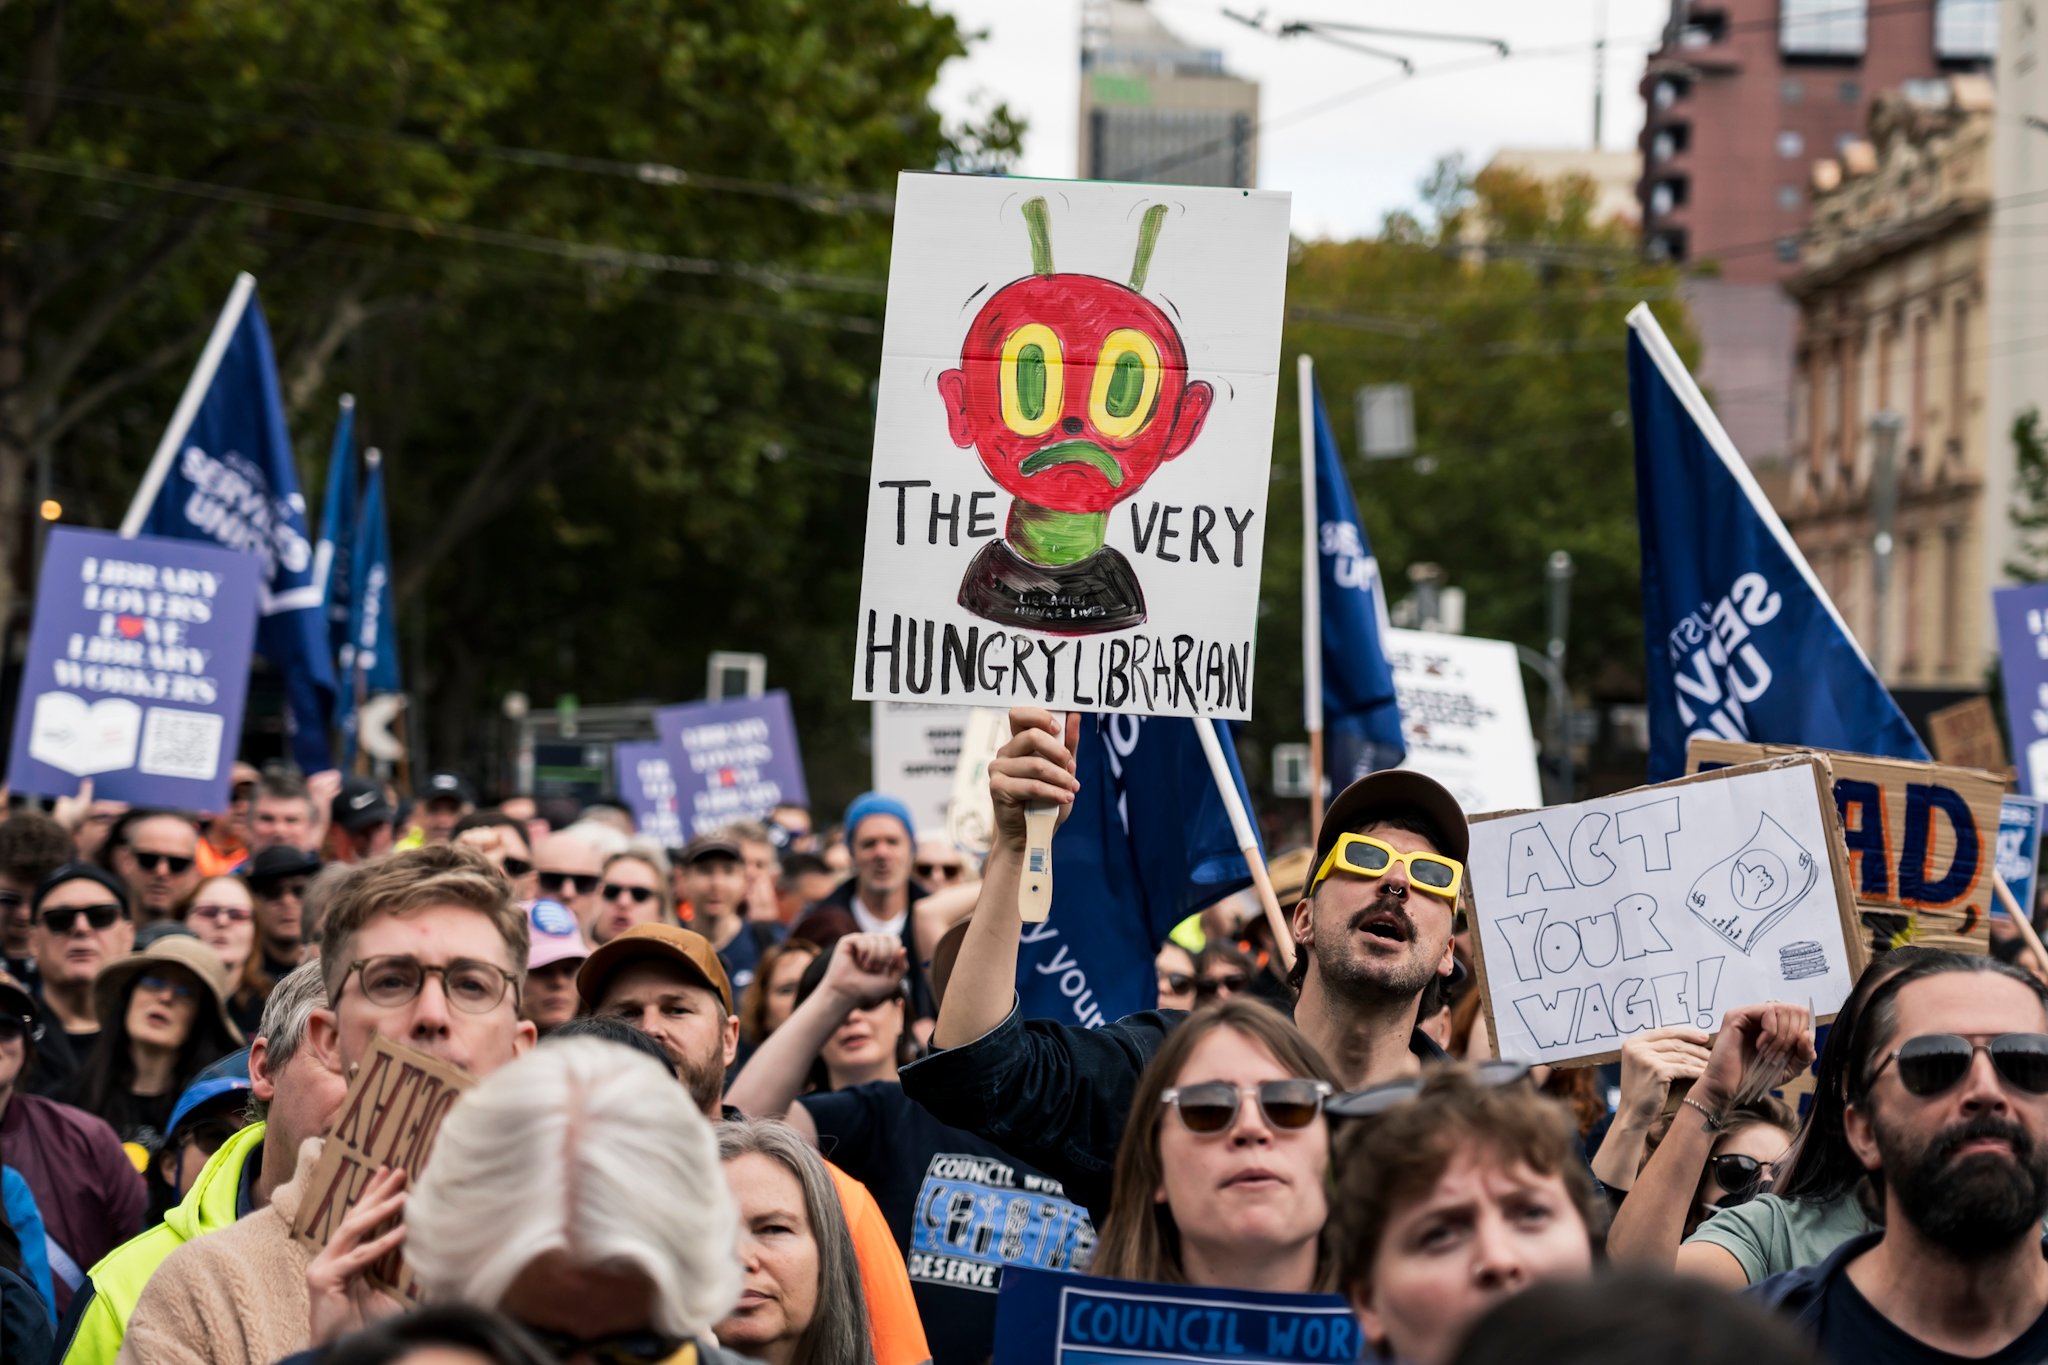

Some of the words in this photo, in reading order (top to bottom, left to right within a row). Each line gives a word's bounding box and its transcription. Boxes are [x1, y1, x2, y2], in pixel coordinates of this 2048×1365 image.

[878, 480, 997, 546] THE
[1131, 501, 1255, 567] VERY
[866, 609, 1068, 702] HUNGRY
[1073, 633, 1250, 715] LIBRARIAN
[1507, 796, 1681, 898] ACT
[1495, 892, 1673, 982] YOUR
[1512, 956, 1725, 1050] WAGE!
[932, 1157, 1016, 1188] COUNCIL
[910, 1254, 997, 1288] DESERVE
[1069, 1301, 1245, 1355] COUNCIL
